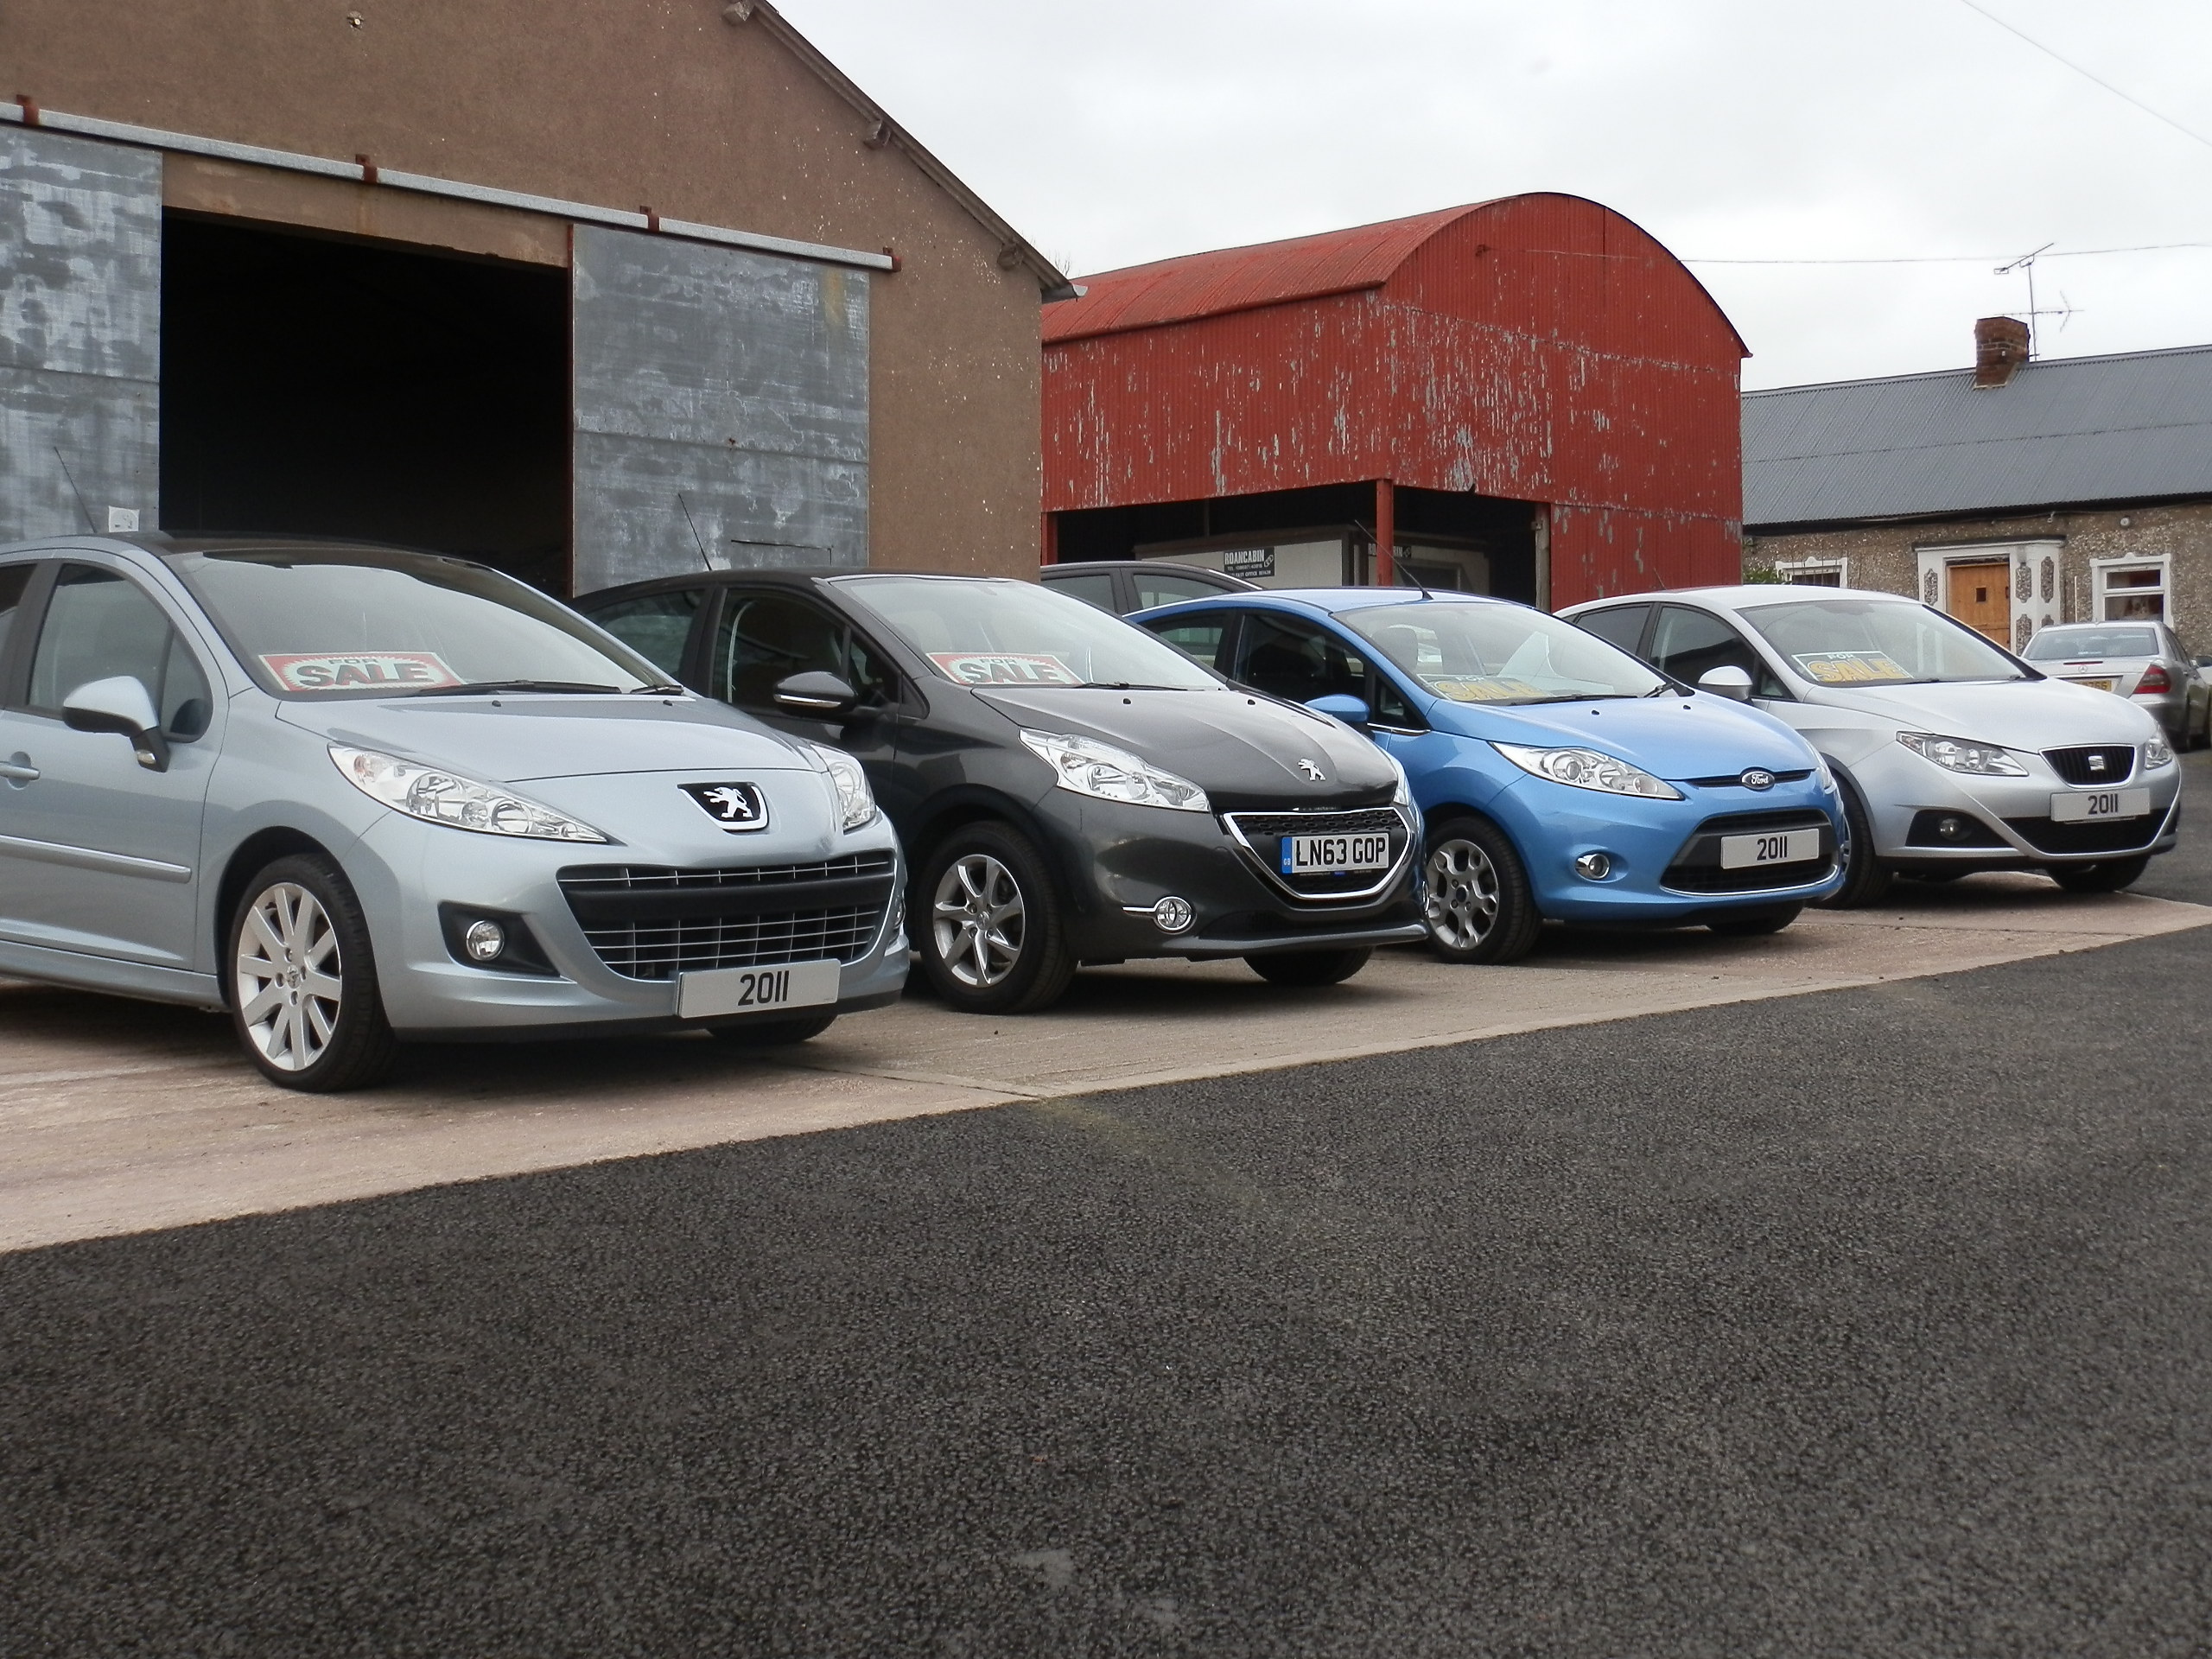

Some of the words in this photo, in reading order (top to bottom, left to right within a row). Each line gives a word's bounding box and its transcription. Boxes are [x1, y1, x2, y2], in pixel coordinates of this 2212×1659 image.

[1224, 549, 1265, 565] ROANCABIN
[296, 663, 435, 687] SALE
[959, 662, 1065, 684] SALE
[1808, 658, 1910, 683] SALE
[1433, 679, 1548, 702] SALE
[1751, 773, 1769, 785] Ford
[2088, 793, 2119, 815] 2011
[1296, 838, 1347, 867] LN63
[1352, 836, 1386, 864] GOP
[1757, 836, 1788, 861] 2011
[737, 969, 790, 1007] 2011
